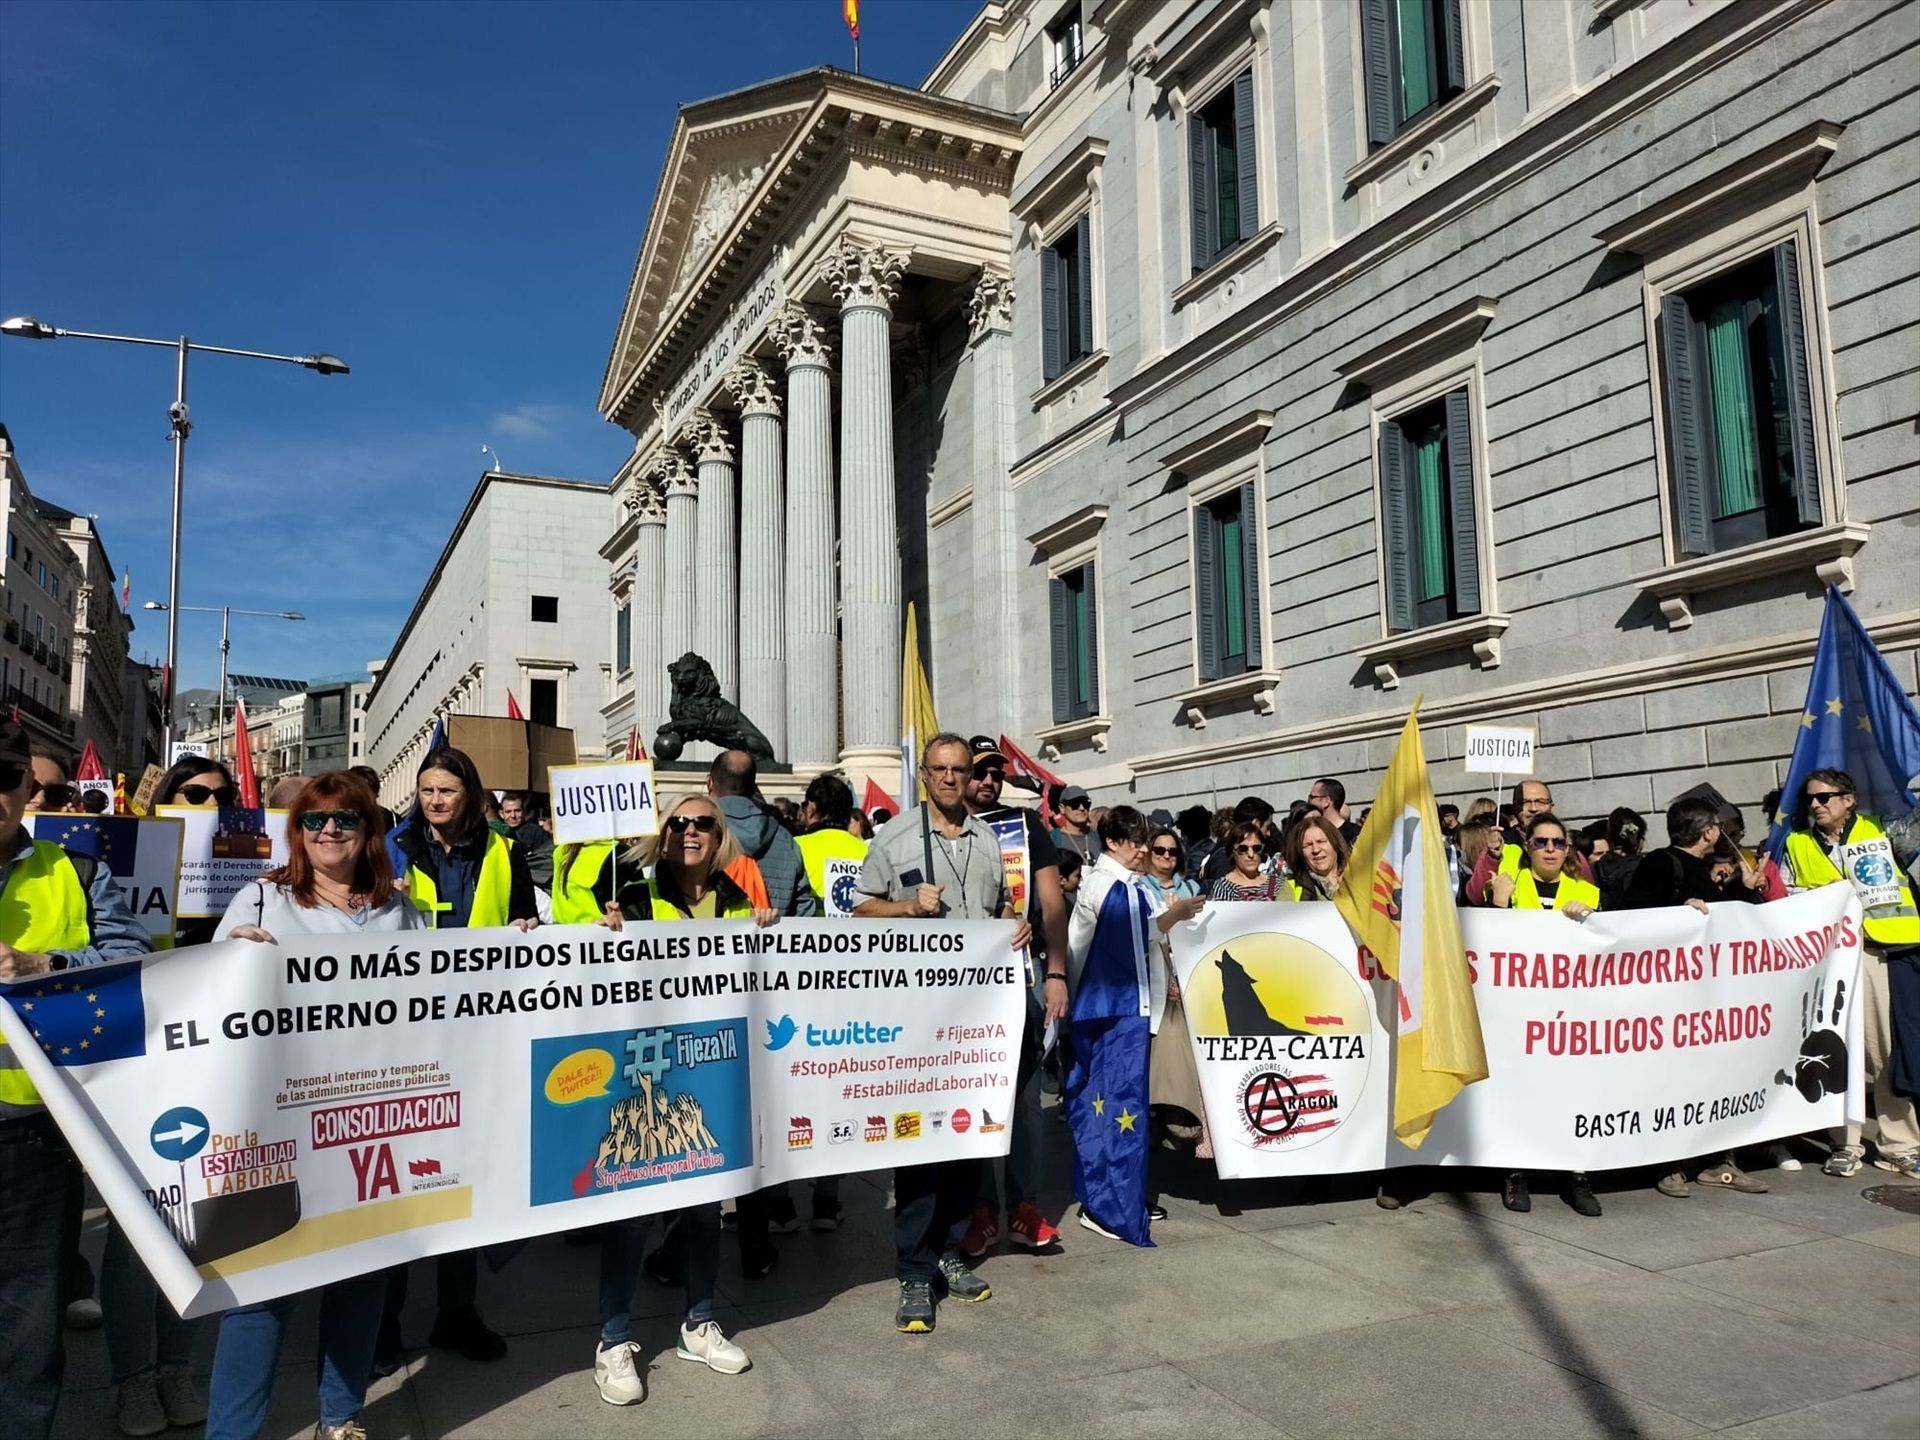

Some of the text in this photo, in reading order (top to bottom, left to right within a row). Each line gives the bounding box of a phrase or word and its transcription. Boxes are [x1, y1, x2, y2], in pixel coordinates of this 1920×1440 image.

[669, 280, 776, 421] CONGRESO DE LOS DIPUTADOS
[1469, 738, 1531, 758] JUSTICIA
[556, 781, 653, 817] JUSTICIA
[1847, 841, 1888, 858] AÑOS
[209, 873, 221, 881] de
[223, 874, 258, 882] confor
[213, 861, 221, 869] el
[223, 861, 262, 870] Derecho
[264, 862, 275, 870] de
[830, 861, 864, 875] AÑOS
[1863, 863, 1884, 877] 22
[185, 886, 240, 896] jurispruden
[1859, 889, 1869, 897] EN
[286, 928, 965, 984] NO MÁS DESPIDOS ILEGALES DE EMPLEADOS PÚBLICOS
[1490, 946, 1704, 988] TRABAJADORAS
[1708, 942, 1722, 978] Y
[163, 965, 1016, 1051] EL GOBIERNO DE ARAGÓN DEBE CUMPLIR LA DIRECTIVA 1999/70/CE
[806, 1021, 903, 1047] twitter
[1525, 1003, 1772, 1056] PÚBLICOS CESADOS
[1196, 1035, 1365, 1061] TEPA-CATA
[286, 1060, 440, 1089] Personal interino y temporal
[557, 1061, 599, 1087] DALE AL
[790, 1049, 1007, 1078] #StopAbusoTemporalPublico
[276, 1072, 451, 1104] de las administraciones públicas
[842, 1073, 1009, 1099] #EstabilidadLaboralYa
[313, 1094, 459, 1143] CONSOLIDACIÓN
[1575, 1087, 1767, 1139] BASTA YA DE ABUSOS
[212, 1129, 258, 1153] Por la
[834, 1126, 852, 1138] S.F.
[203, 1140, 296, 1176] ESTABILIDAD
[206, 1163, 297, 1197] LABORAL
[348, 1142, 400, 1202] YA
[412, 1178, 460, 1191] INTERSINDICAL
